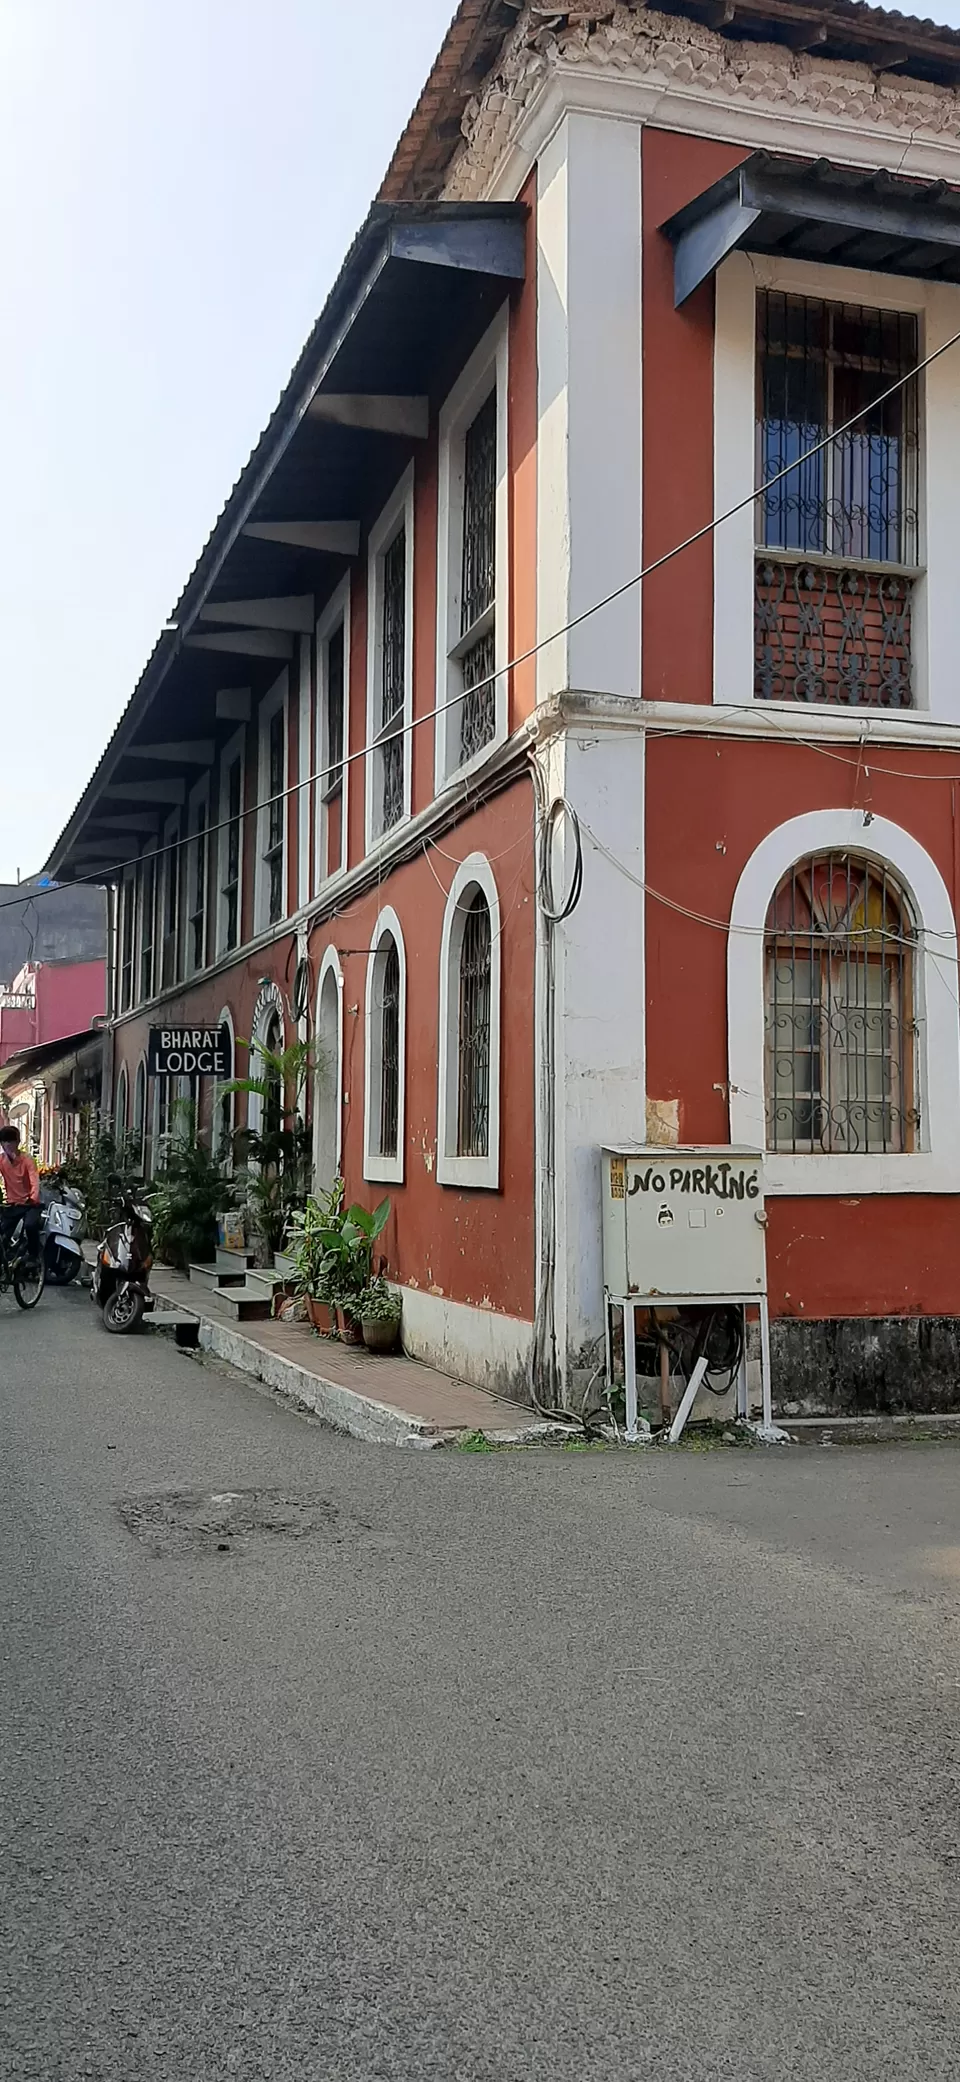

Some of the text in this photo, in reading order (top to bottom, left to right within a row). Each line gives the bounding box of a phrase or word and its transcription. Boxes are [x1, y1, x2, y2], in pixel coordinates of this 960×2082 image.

[161, 1031, 221, 1048] BHARAT
[156, 1052, 225, 1072] LODGE
[628, 1168, 665, 1195] NO
[669, 1163, 760, 1200] PARKING
